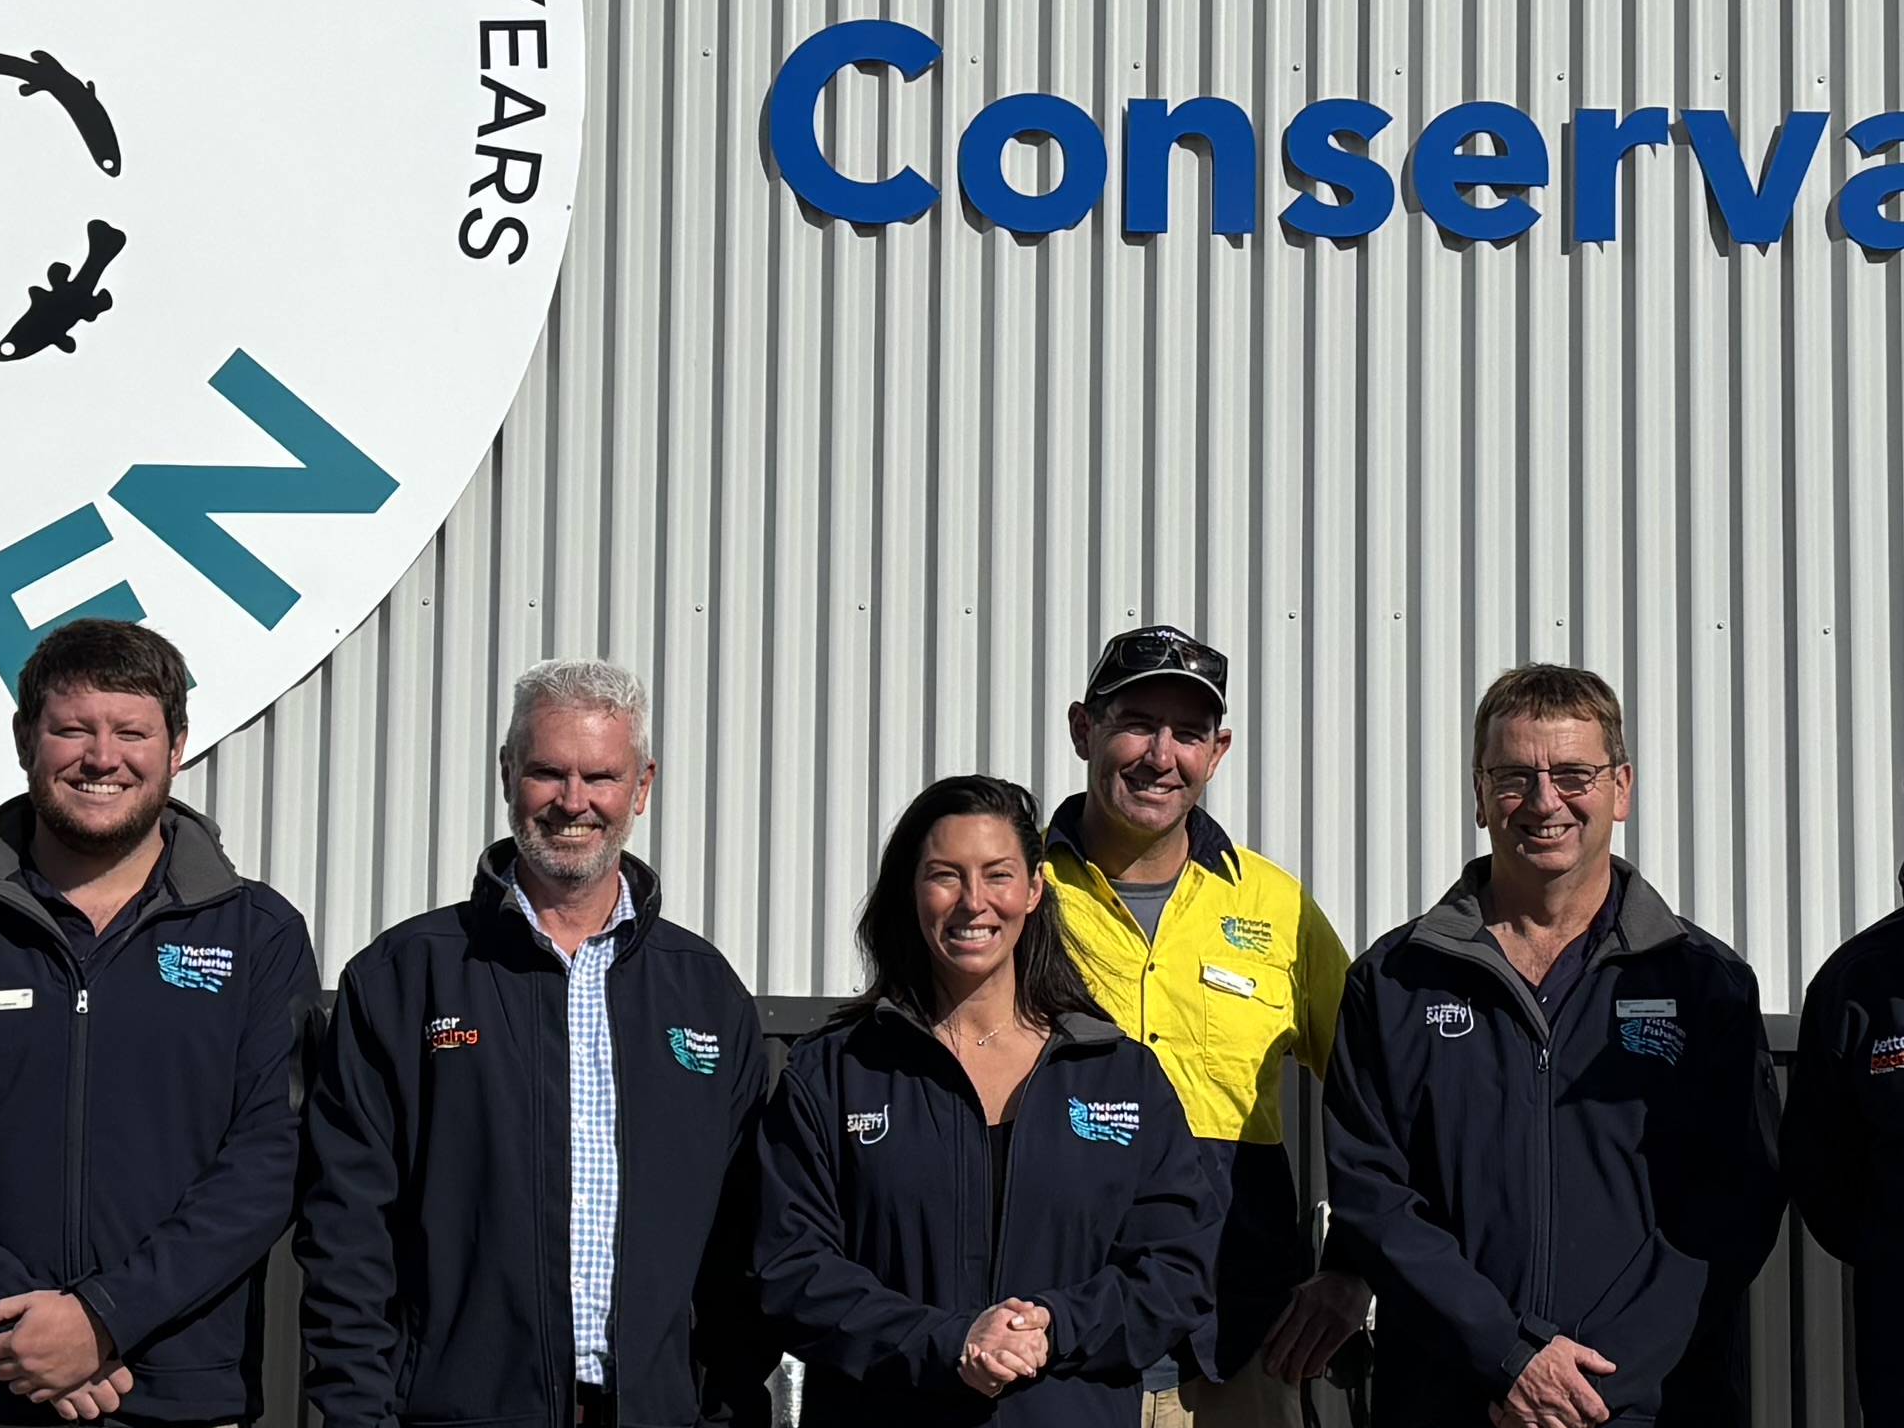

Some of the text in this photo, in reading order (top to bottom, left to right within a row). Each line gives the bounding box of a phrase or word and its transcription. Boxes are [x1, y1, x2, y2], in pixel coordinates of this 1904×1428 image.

[181, 944, 233, 958] Victorian
[181, 956, 232, 971] Fisheries
[1426, 1009, 1467, 1025] SAFETY
[1087, 1100, 1139, 1112] Victorian
[847, 1118, 883, 1132] SAFETY
